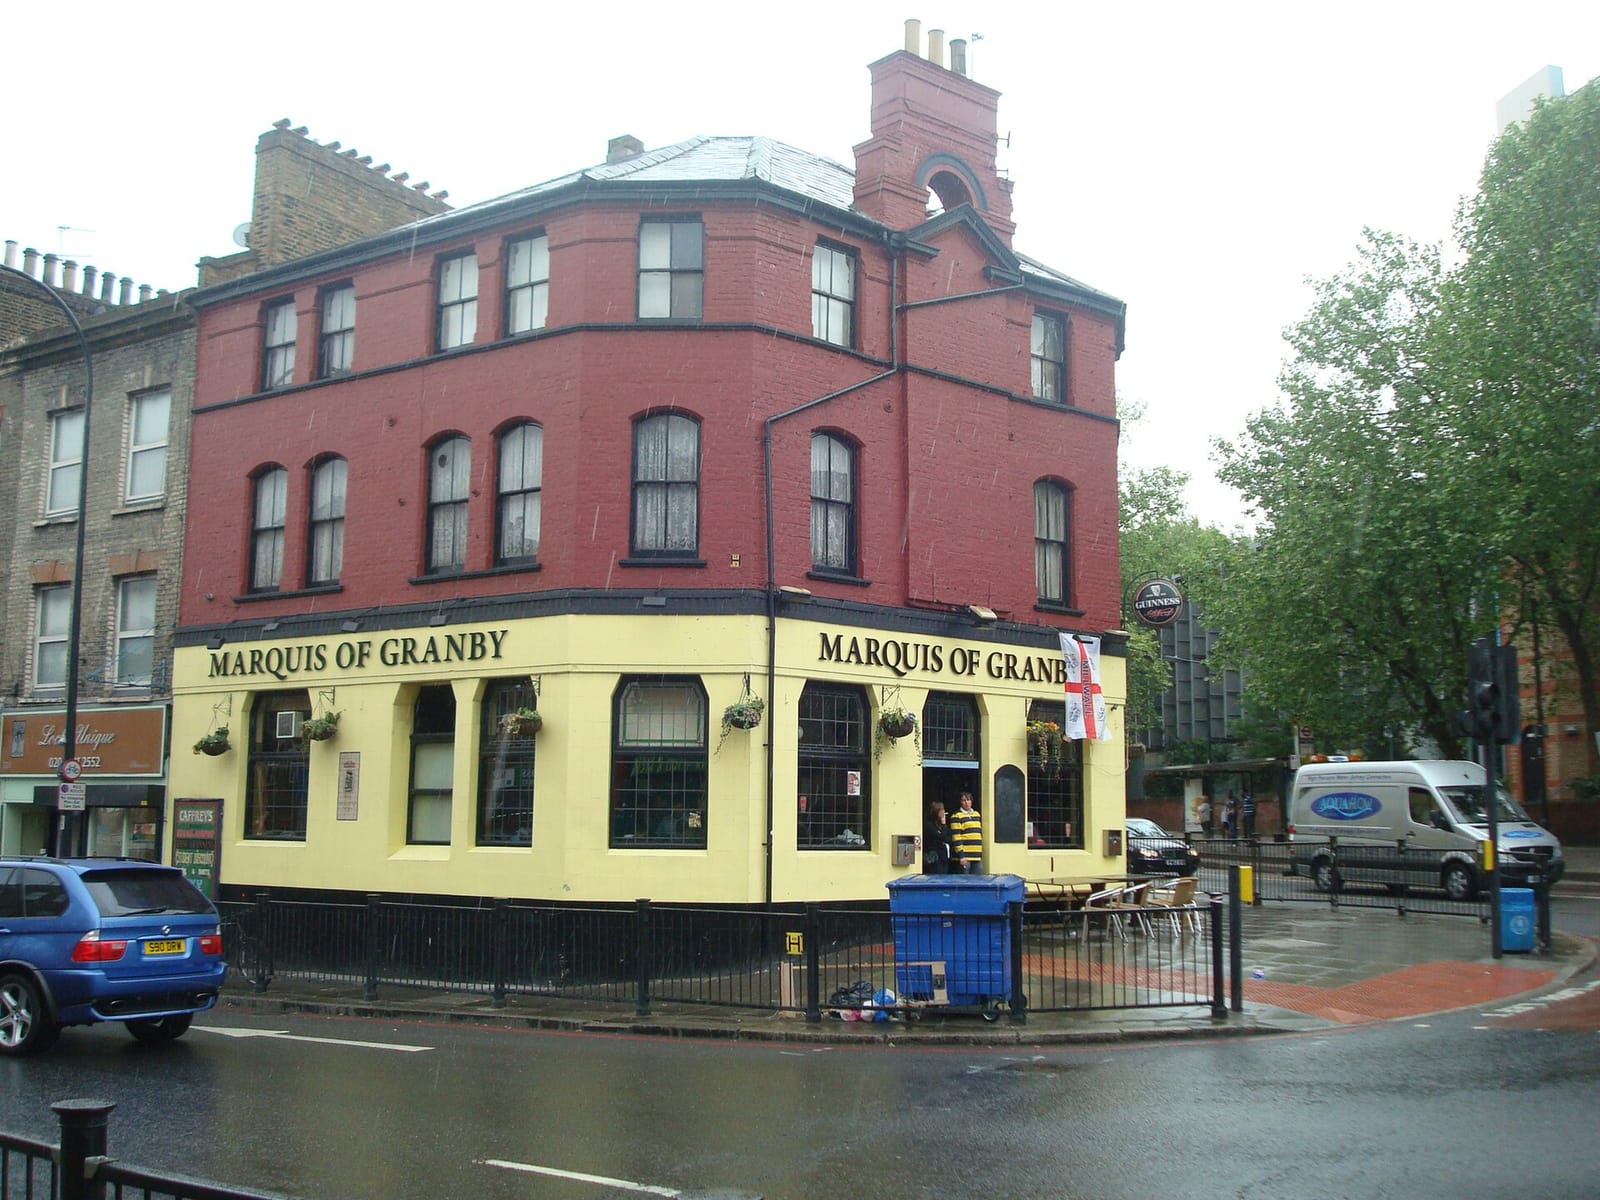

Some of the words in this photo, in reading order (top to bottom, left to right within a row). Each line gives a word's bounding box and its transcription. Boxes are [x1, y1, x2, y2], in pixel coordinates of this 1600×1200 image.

[1135, 597, 1181, 609] GUINNESS
[208, 644, 327, 680] MARQUIS
[335, 640, 372, 669] OF
[380, 630, 508, 666] GRANBY
[819, 633, 943, 677] MARQUIS
[950, 647, 980, 676] OF
[986, 651, 1067, 684] GRANB
[1081, 660, 1093, 718] MILLWALL
[75, 724, 115, 750] Unique
[81, 756, 101, 768] 2552
[179, 809, 213, 822] CAFFREY'S
